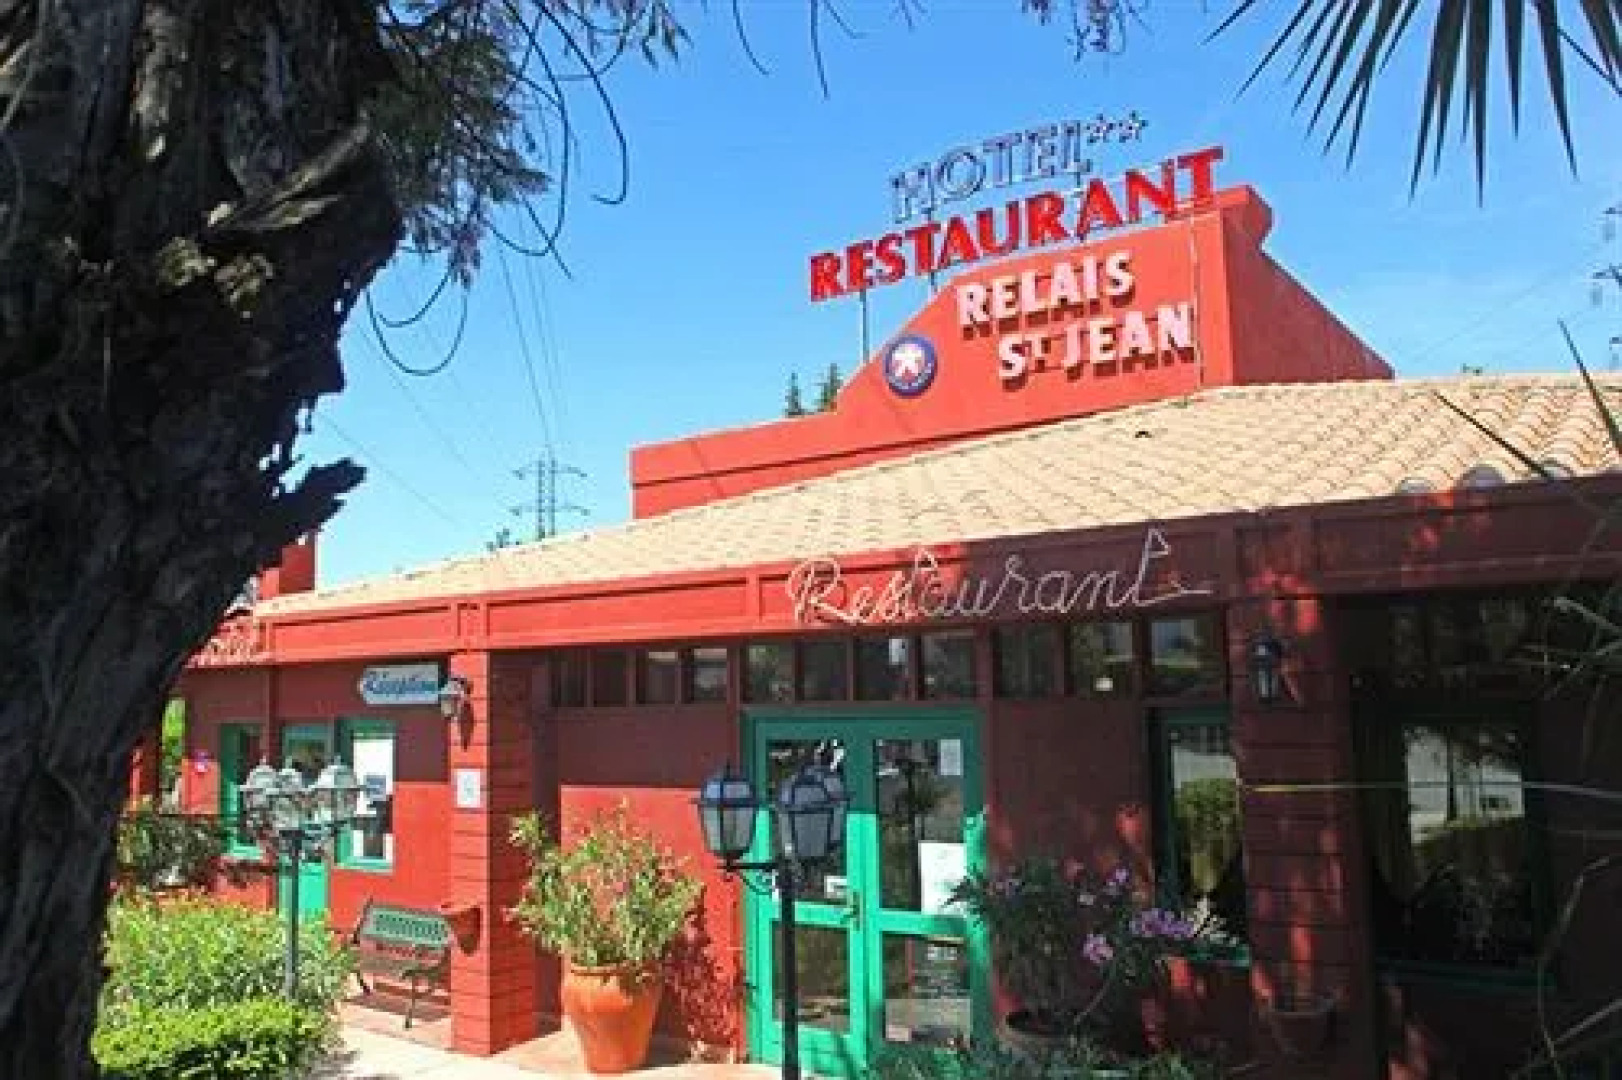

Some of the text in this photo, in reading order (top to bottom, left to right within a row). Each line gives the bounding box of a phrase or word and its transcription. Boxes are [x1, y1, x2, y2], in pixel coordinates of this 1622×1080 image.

[890, 119, 1092, 223] HOTEL
[809, 146, 1223, 302] RESTAURANT
[956, 252, 1134, 334] RELAIS
[1060, 302, 1196, 370] JEAN
[785, 527, 1212, 625] Restaurant
